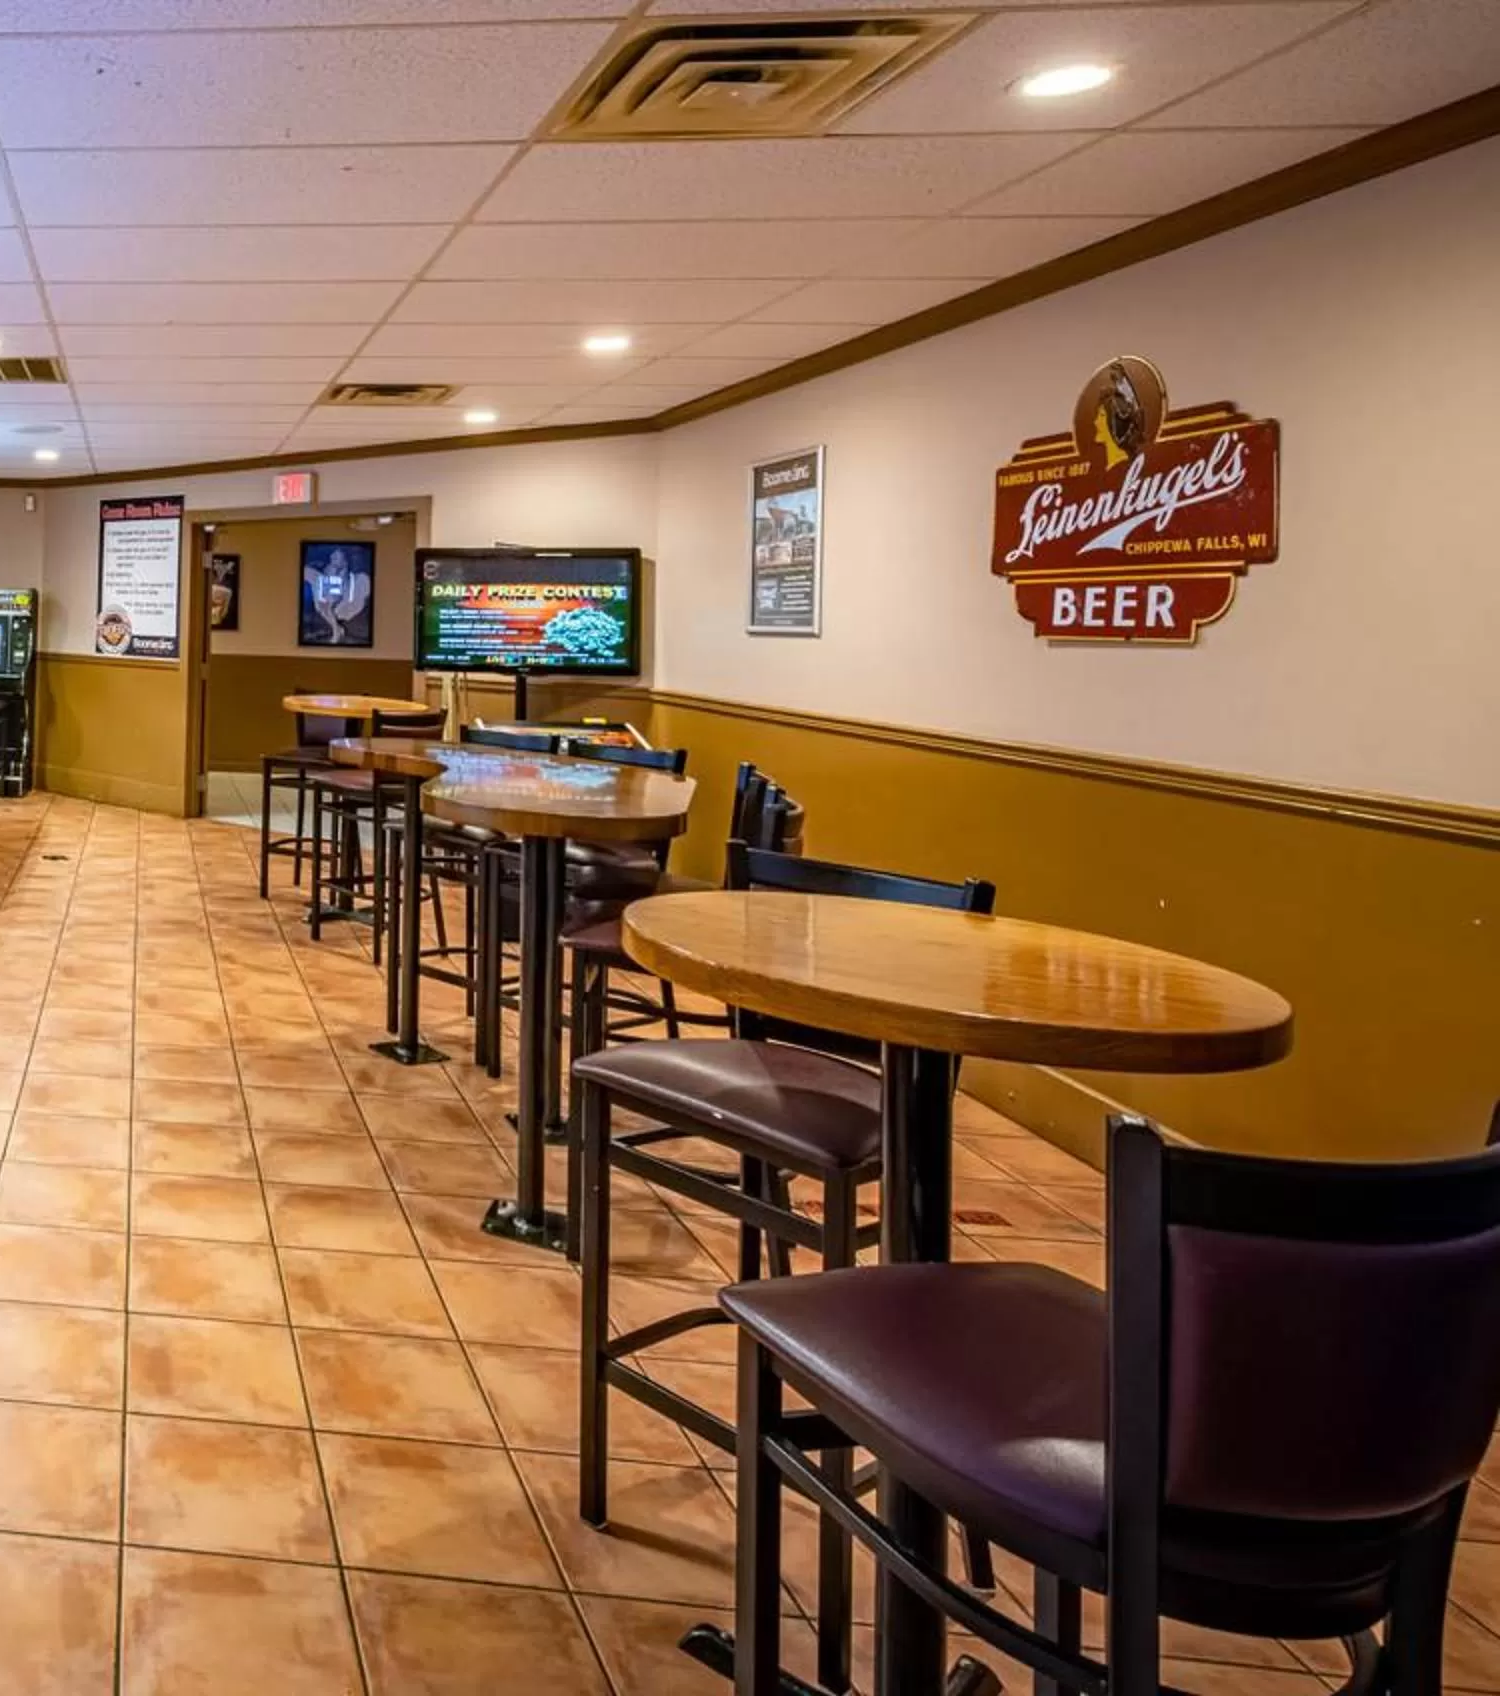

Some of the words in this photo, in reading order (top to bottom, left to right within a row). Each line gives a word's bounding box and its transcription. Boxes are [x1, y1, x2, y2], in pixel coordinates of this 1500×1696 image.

[999, 471, 1034, 487] FAMOUS
[1037, 466, 1066, 482] SINCE
[1125, 539, 1192, 555] CHIPPEWA
[1197, 536, 1244, 551] FALLS,
[1248, 533, 1267, 548] WI
[432, 585, 483, 597] DAILY
[487, 585, 537, 598] PRIZE
[543, 586, 628, 599] CONTEST
[1052, 585, 1176, 628] BEER
